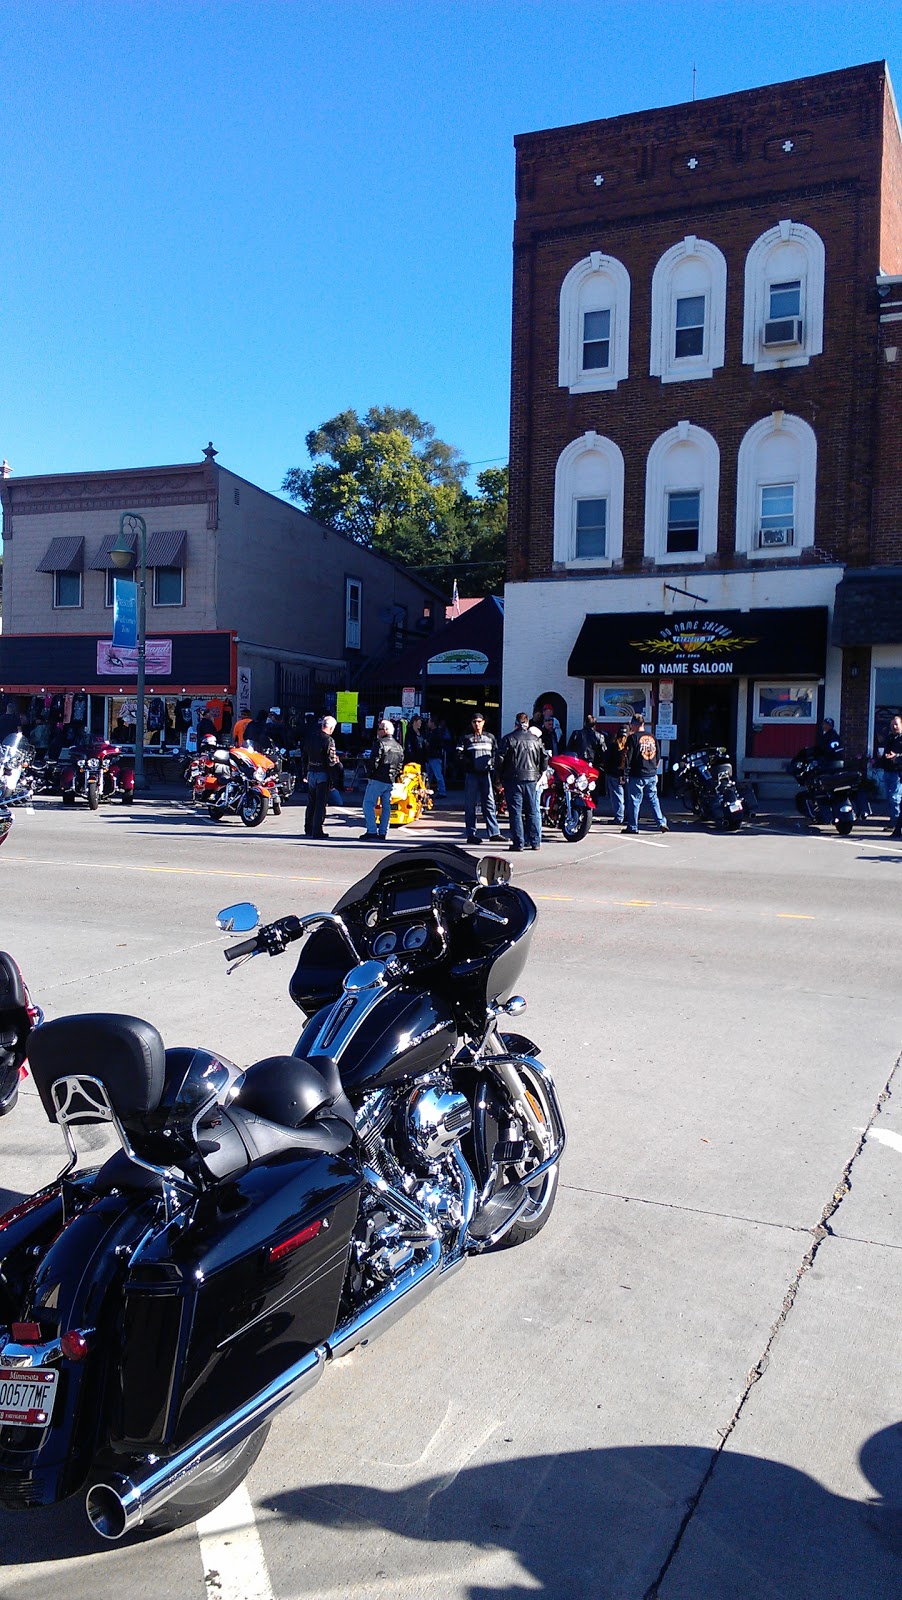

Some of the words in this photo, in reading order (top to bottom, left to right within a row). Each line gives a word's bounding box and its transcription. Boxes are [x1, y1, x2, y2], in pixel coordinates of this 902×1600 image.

[674, 621, 699, 632] NAME
[702, 621, 732, 637] SALOON
[641, 663, 655, 674] NO
[659, 663, 689, 674] NAME
[692, 662, 733, 673] SALOON
[9, 1371, 38, 1381] Minnesota
[0, 1383, 50, 1408] 00577MF
